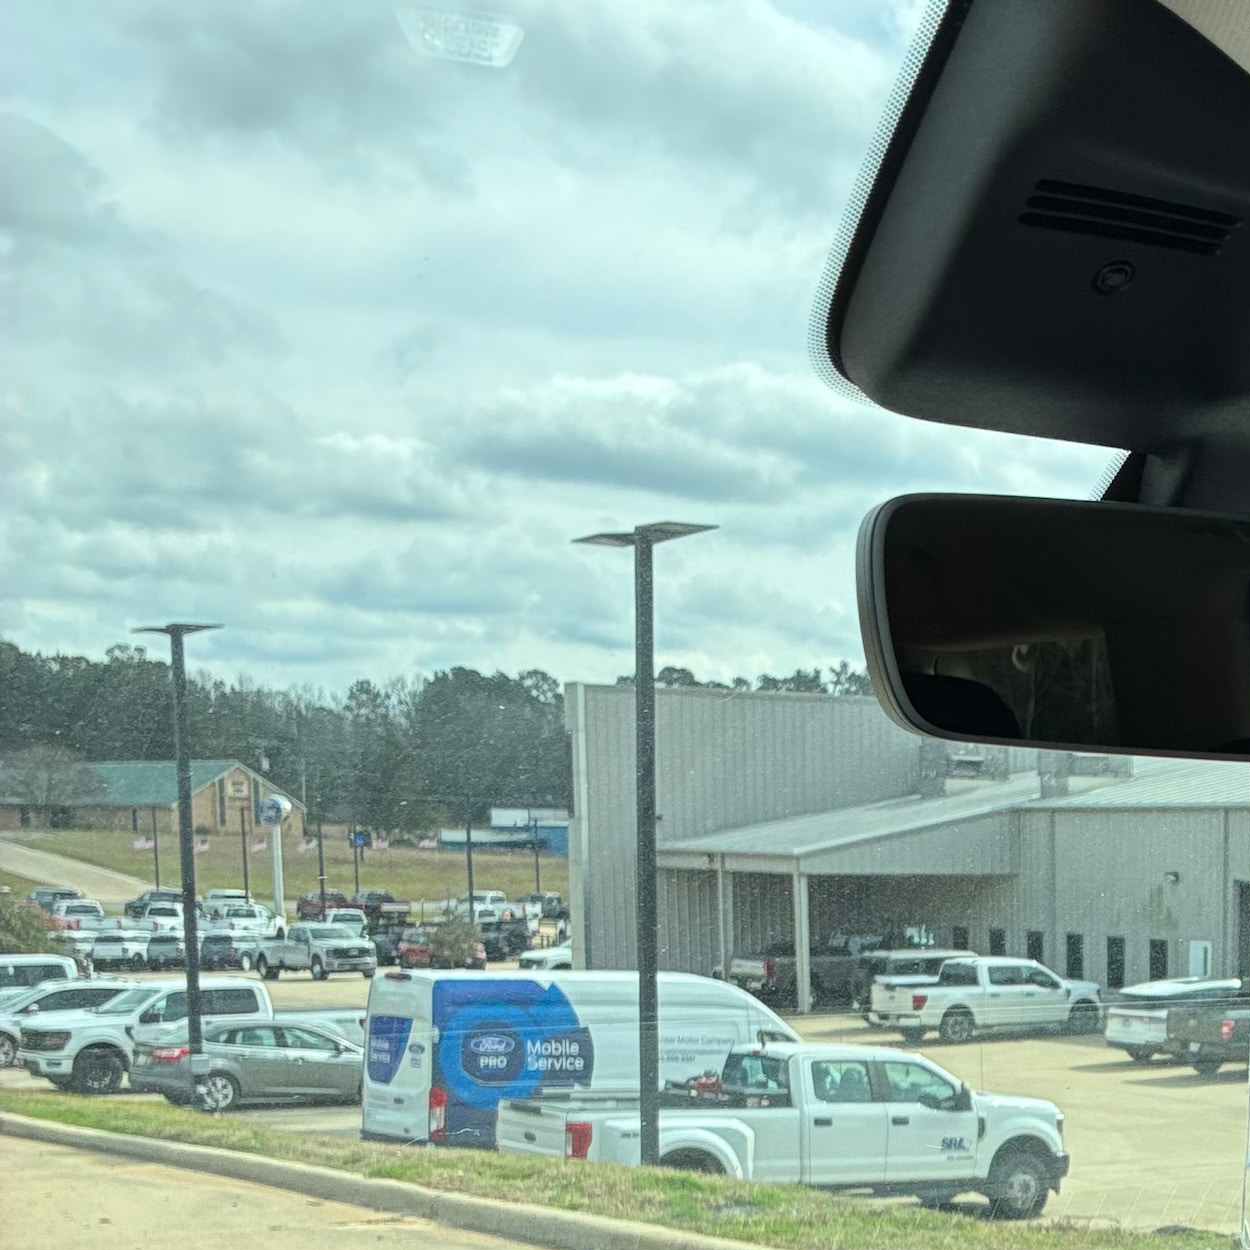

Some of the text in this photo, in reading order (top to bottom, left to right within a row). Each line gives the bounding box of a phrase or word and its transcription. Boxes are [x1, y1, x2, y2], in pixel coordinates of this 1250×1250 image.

[526, 1039, 581, 1056] Mobile
[479, 1055, 507, 1069] PRO
[526, 1055, 585, 1072] Service
